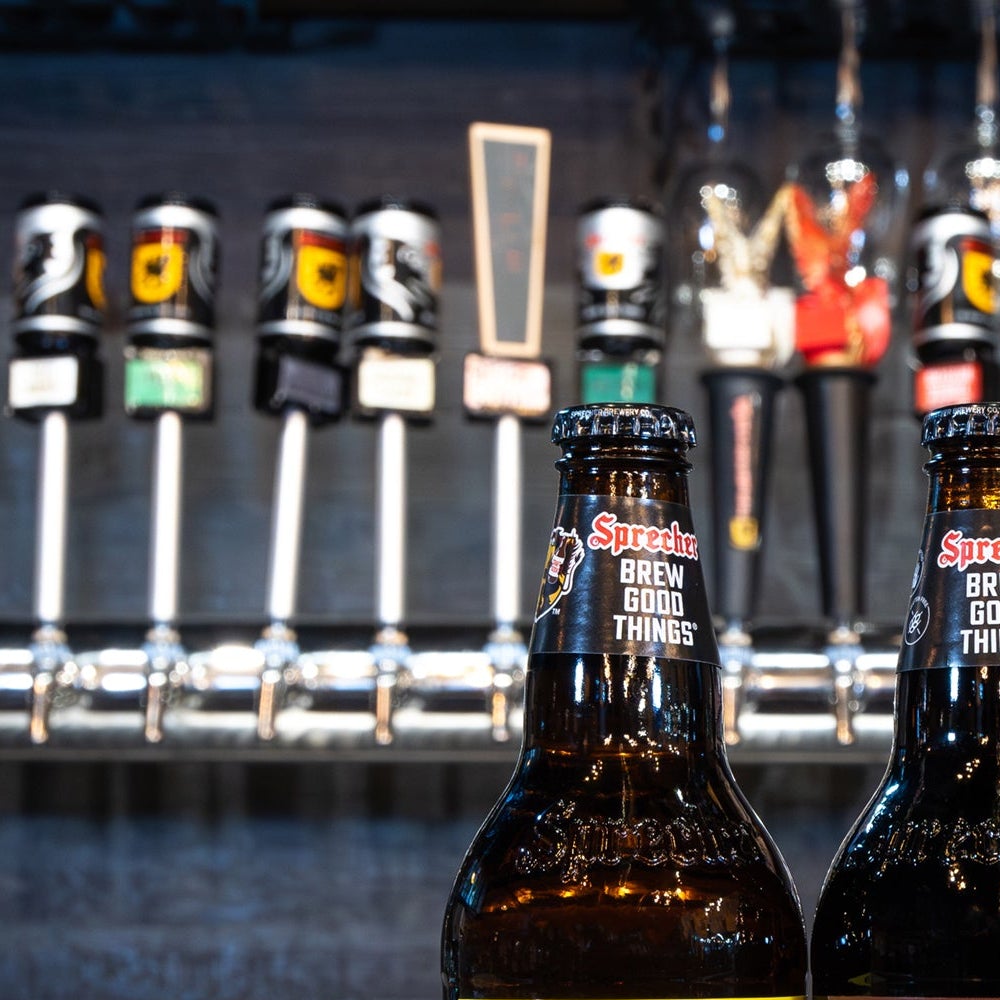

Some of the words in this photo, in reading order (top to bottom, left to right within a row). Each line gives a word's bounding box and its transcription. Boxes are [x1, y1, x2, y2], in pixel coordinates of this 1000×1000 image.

[587, 511, 699, 561] Sprecher
[620, 558, 684, 590] BREW
[624, 587, 684, 617] GOOD
